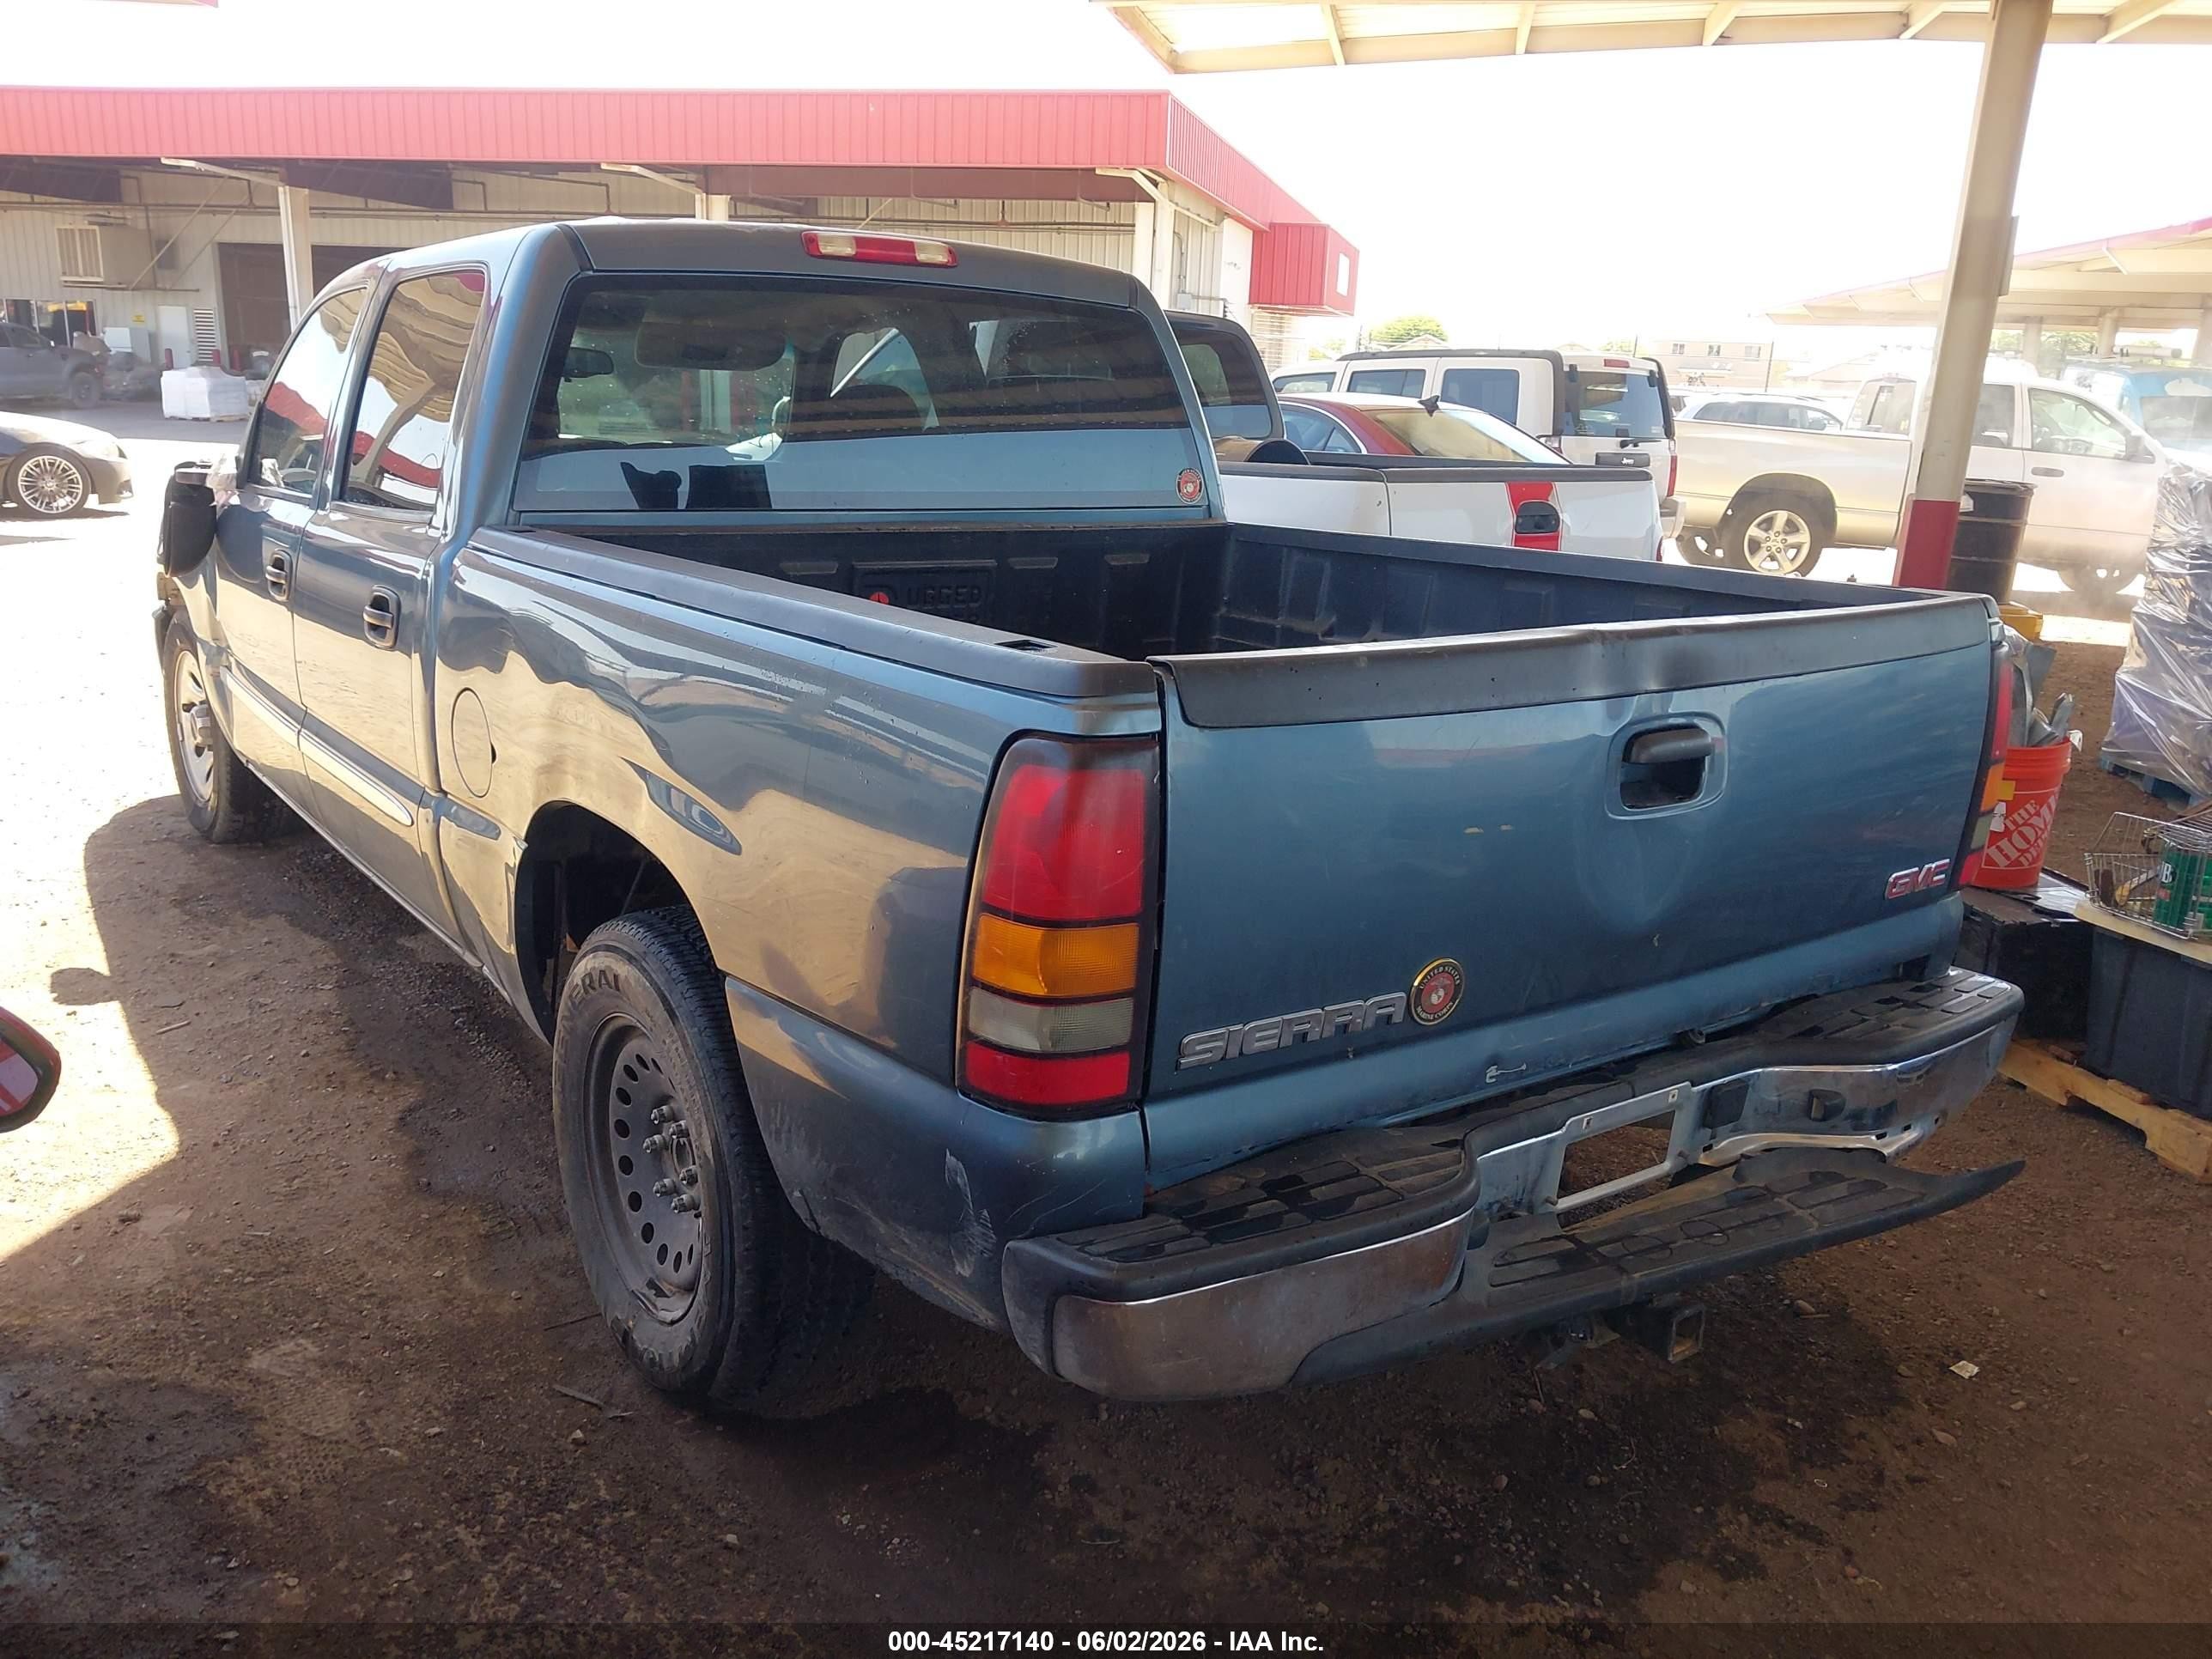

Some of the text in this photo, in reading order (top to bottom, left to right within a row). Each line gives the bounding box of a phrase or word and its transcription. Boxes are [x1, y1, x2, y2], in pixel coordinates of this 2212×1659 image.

[1987, 790, 2058, 867] HOM
[2004, 799, 2039, 831] THE
[1884, 859, 1950, 899] GMC
[1419, 966, 1461, 989] UNITED STATES
[1415, 1005, 1435, 1020] MARINE
[1179, 992, 1406, 1070] SIERRA
